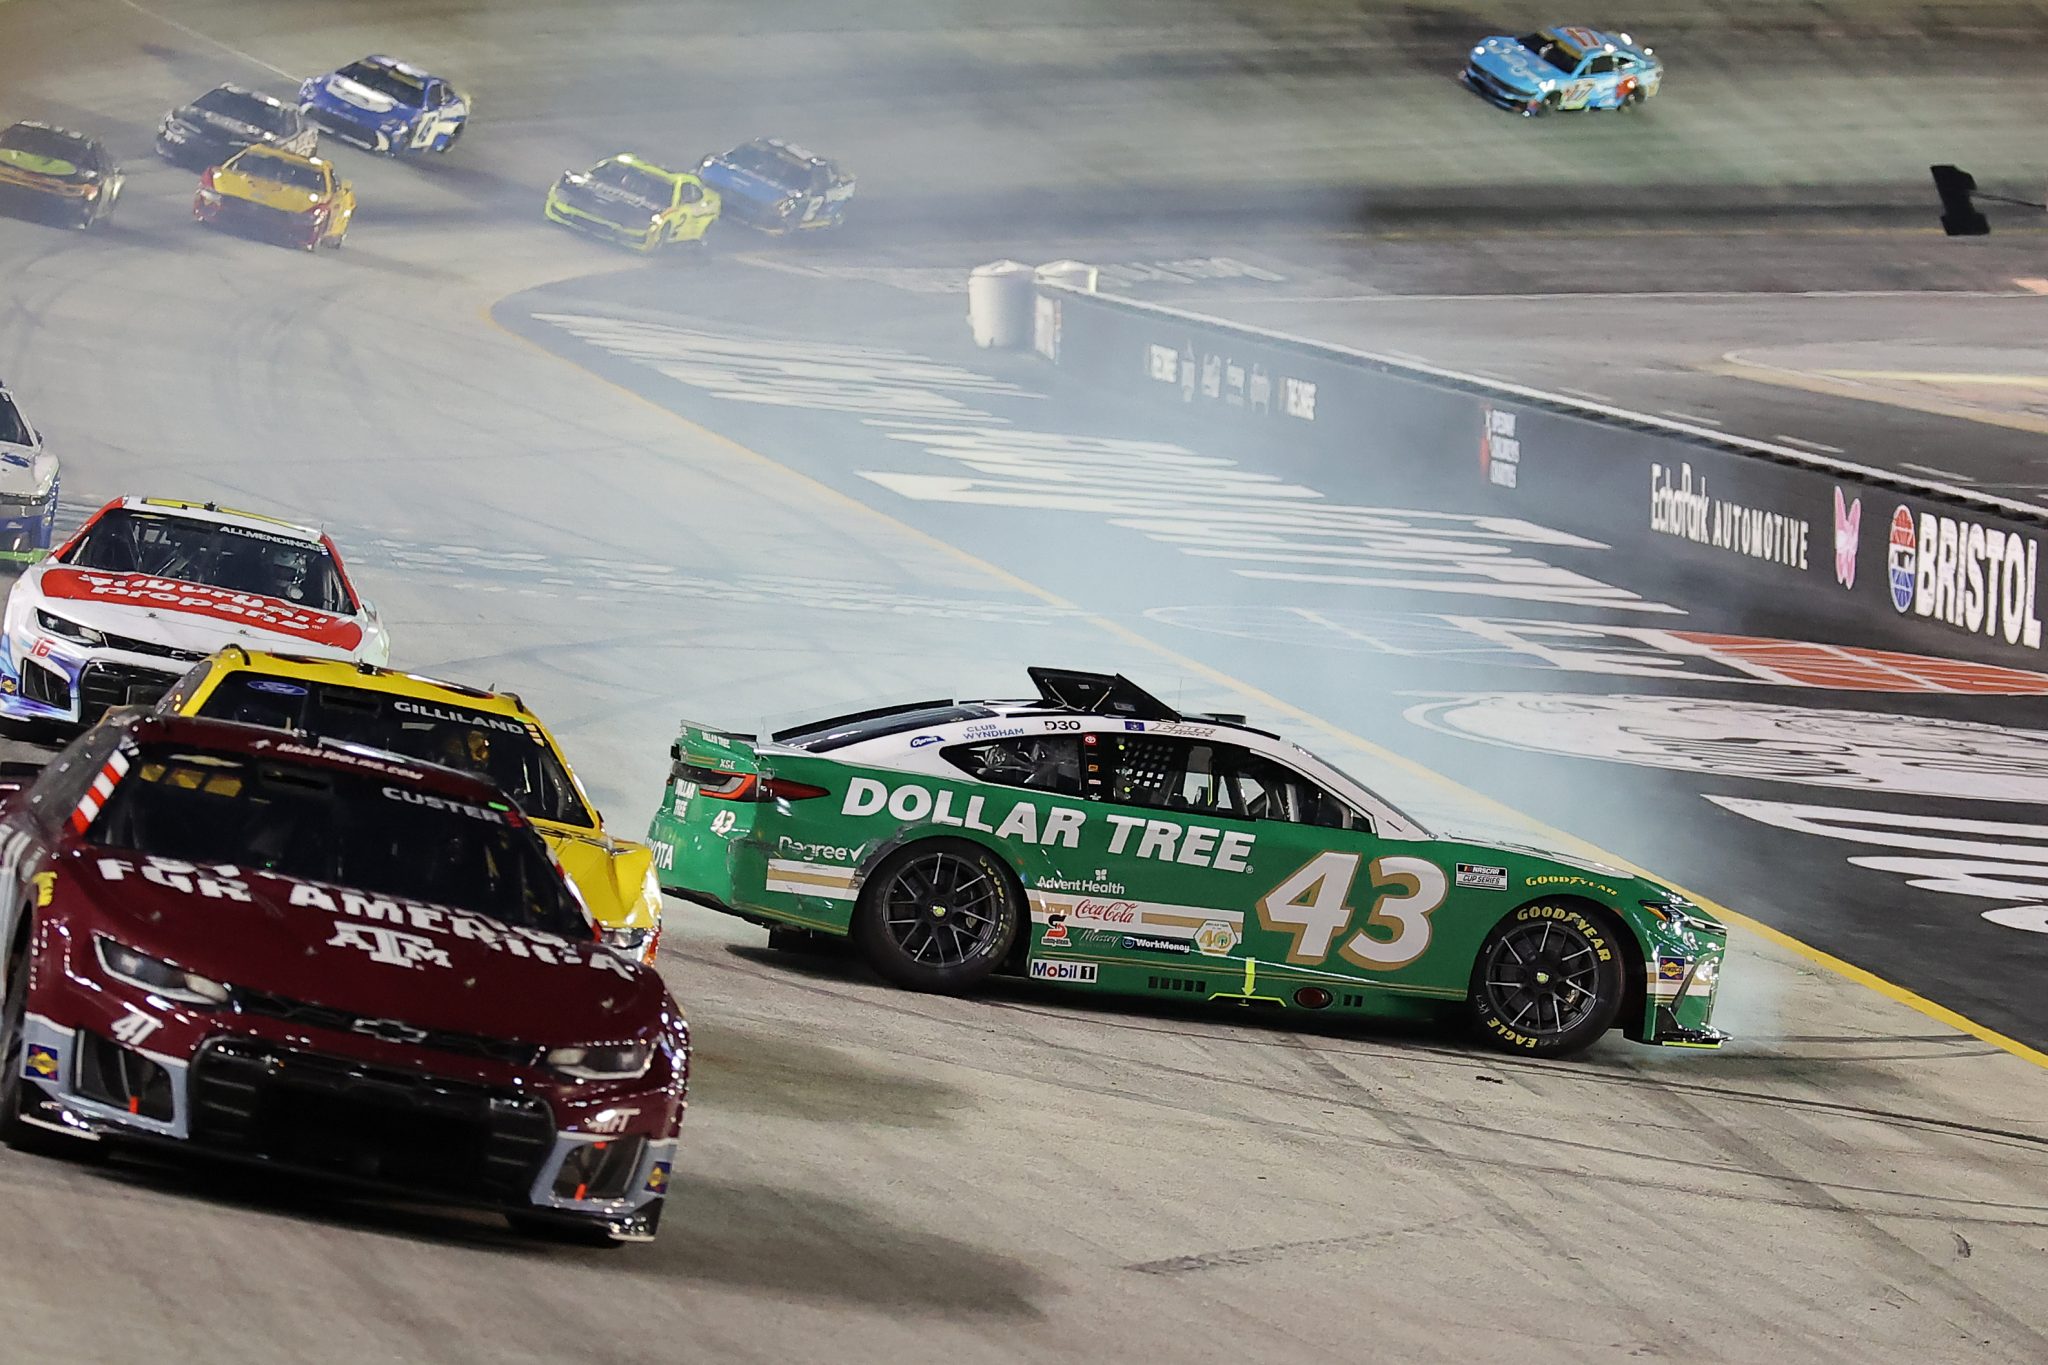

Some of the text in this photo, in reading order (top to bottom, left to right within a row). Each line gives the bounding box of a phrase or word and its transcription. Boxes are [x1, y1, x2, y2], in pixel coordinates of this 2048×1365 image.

[1712, 499, 1810, 570] AUTOMOTIVE
[1914, 511, 2042, 650] BRISTOL
[394, 701, 524, 735] GILLILAND
[966, 724, 997, 732] CLUB
[962, 728, 1025, 740] WYNDHAM
[719, 759, 736, 769] XSE
[382, 787, 503, 824] CUSTER
[711, 810, 736, 834] 43
[841, 777, 1257, 873] DOLLAR TREE
[1462, 874, 1478, 882] CUP
[1472, 866, 1500, 876] NASCAR
[1036, 875, 1125, 895] AdventHealth
[1255, 850, 1449, 972] 43
[1136, 938, 1190, 954] WorkMoney
[1516, 906, 1612, 962] GOODYEAR
[1032, 962, 1095, 979] Mobil 1
[1486, 1016, 1538, 1049] EAGLE
